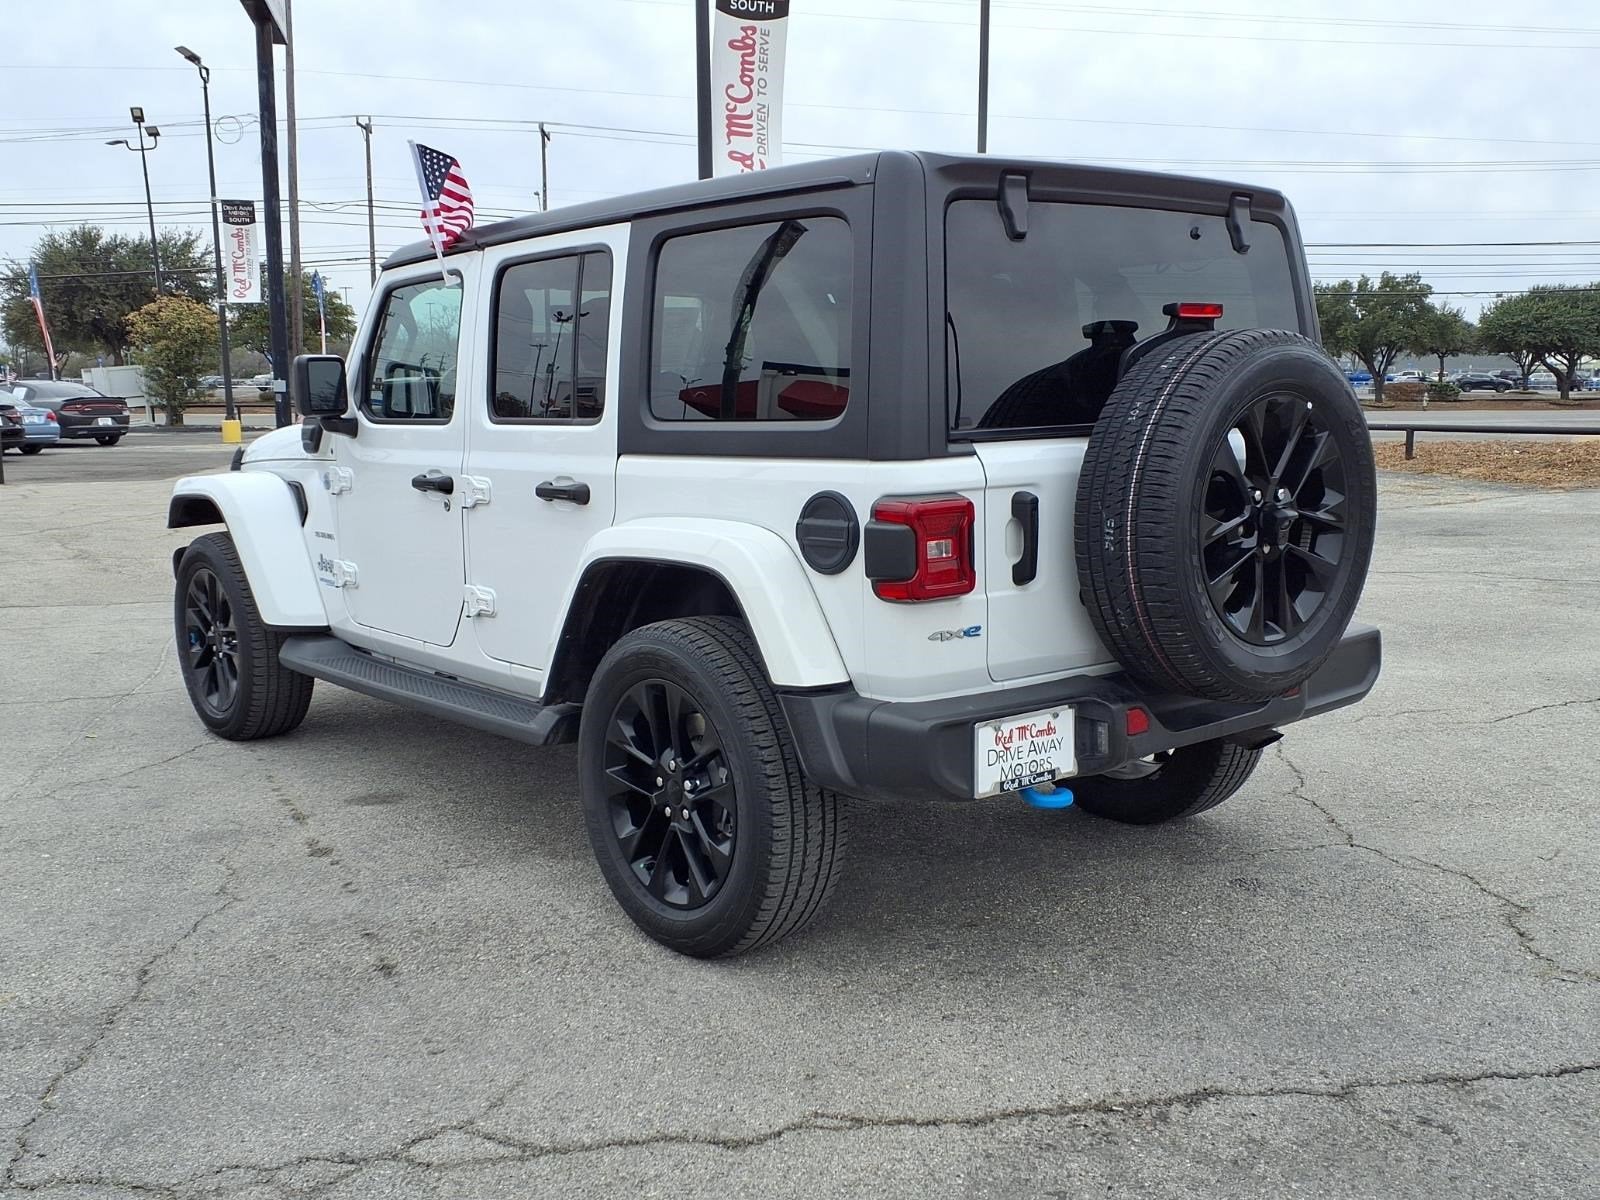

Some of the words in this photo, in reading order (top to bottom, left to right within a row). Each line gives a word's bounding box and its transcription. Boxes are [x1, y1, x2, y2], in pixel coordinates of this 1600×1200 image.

[730, 0, 775, 13] SOUTH
[759, 27, 770, 73] SERVE
[725, 25, 757, 145] McCombs
[757, 78, 768, 97] TO
[757, 103, 770, 156] DRIVEN
[230, 227, 246, 277] McCombs
[233, 278, 252, 299] Red
[995, 728, 1014, 751] Red
[1015, 721, 1057, 742] McCombs
[987, 745, 1024, 767] DRIVE
[1026, 736, 1064, 758] AWAY
[1000, 756, 1053, 781] MOTORS
[1003, 780, 1019, 791] Red
[1021, 772, 1052, 786] McCombs
